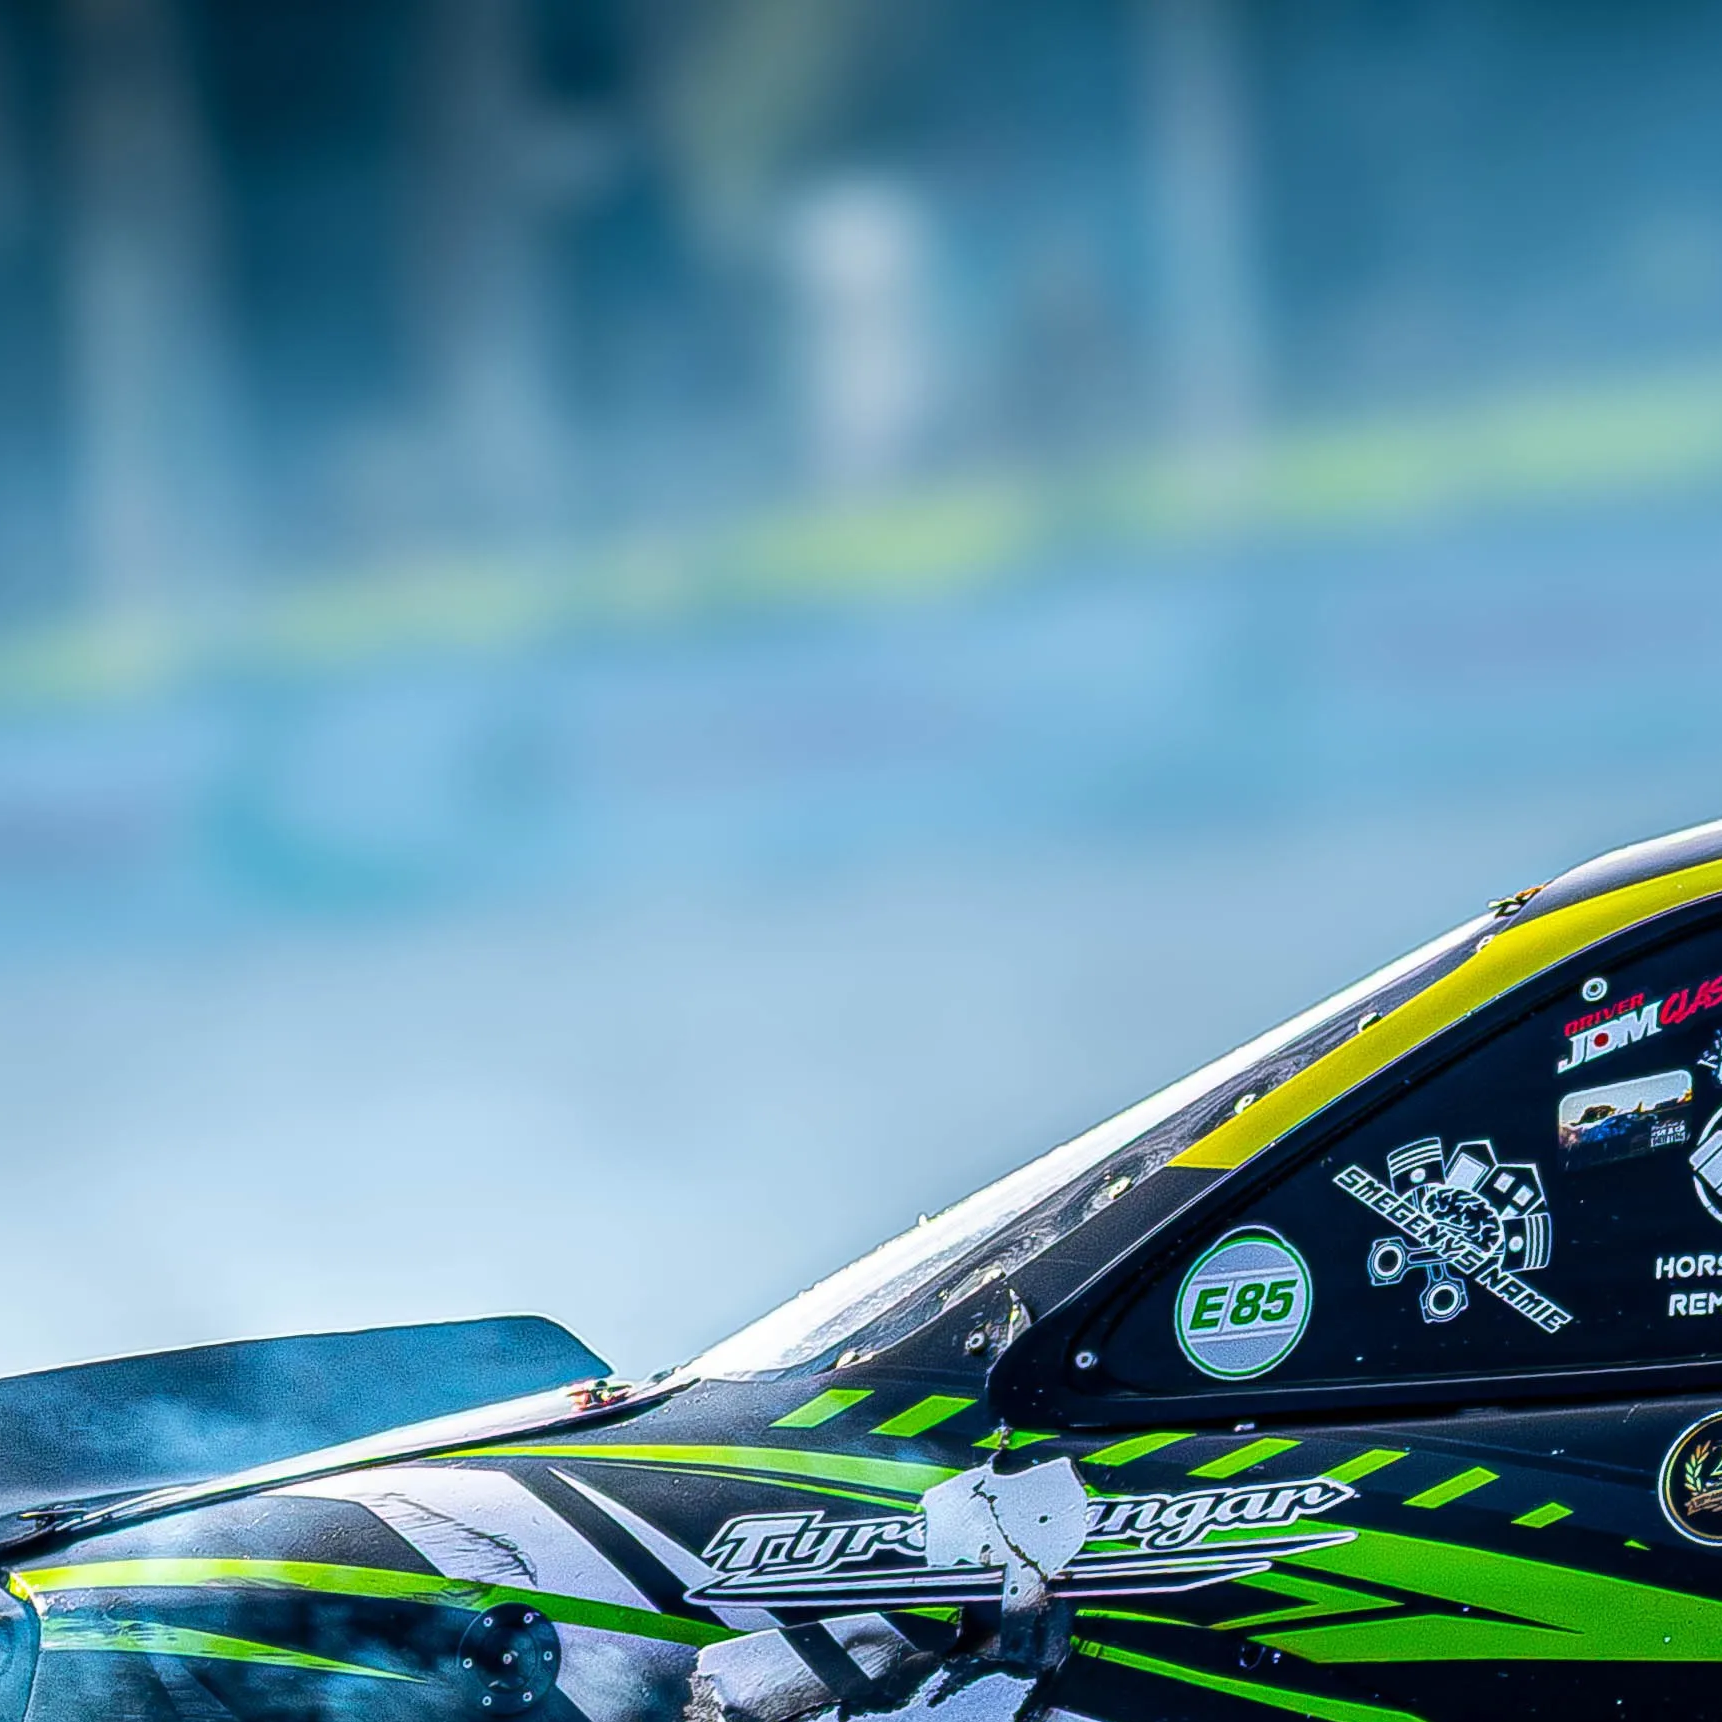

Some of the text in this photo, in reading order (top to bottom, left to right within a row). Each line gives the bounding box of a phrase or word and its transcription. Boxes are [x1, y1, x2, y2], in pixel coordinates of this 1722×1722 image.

[1557, 1000, 1663, 1074] JDM
[1564, 993, 1645, 1037] DRIVER
[1188, 1278, 1299, 1340] E85
